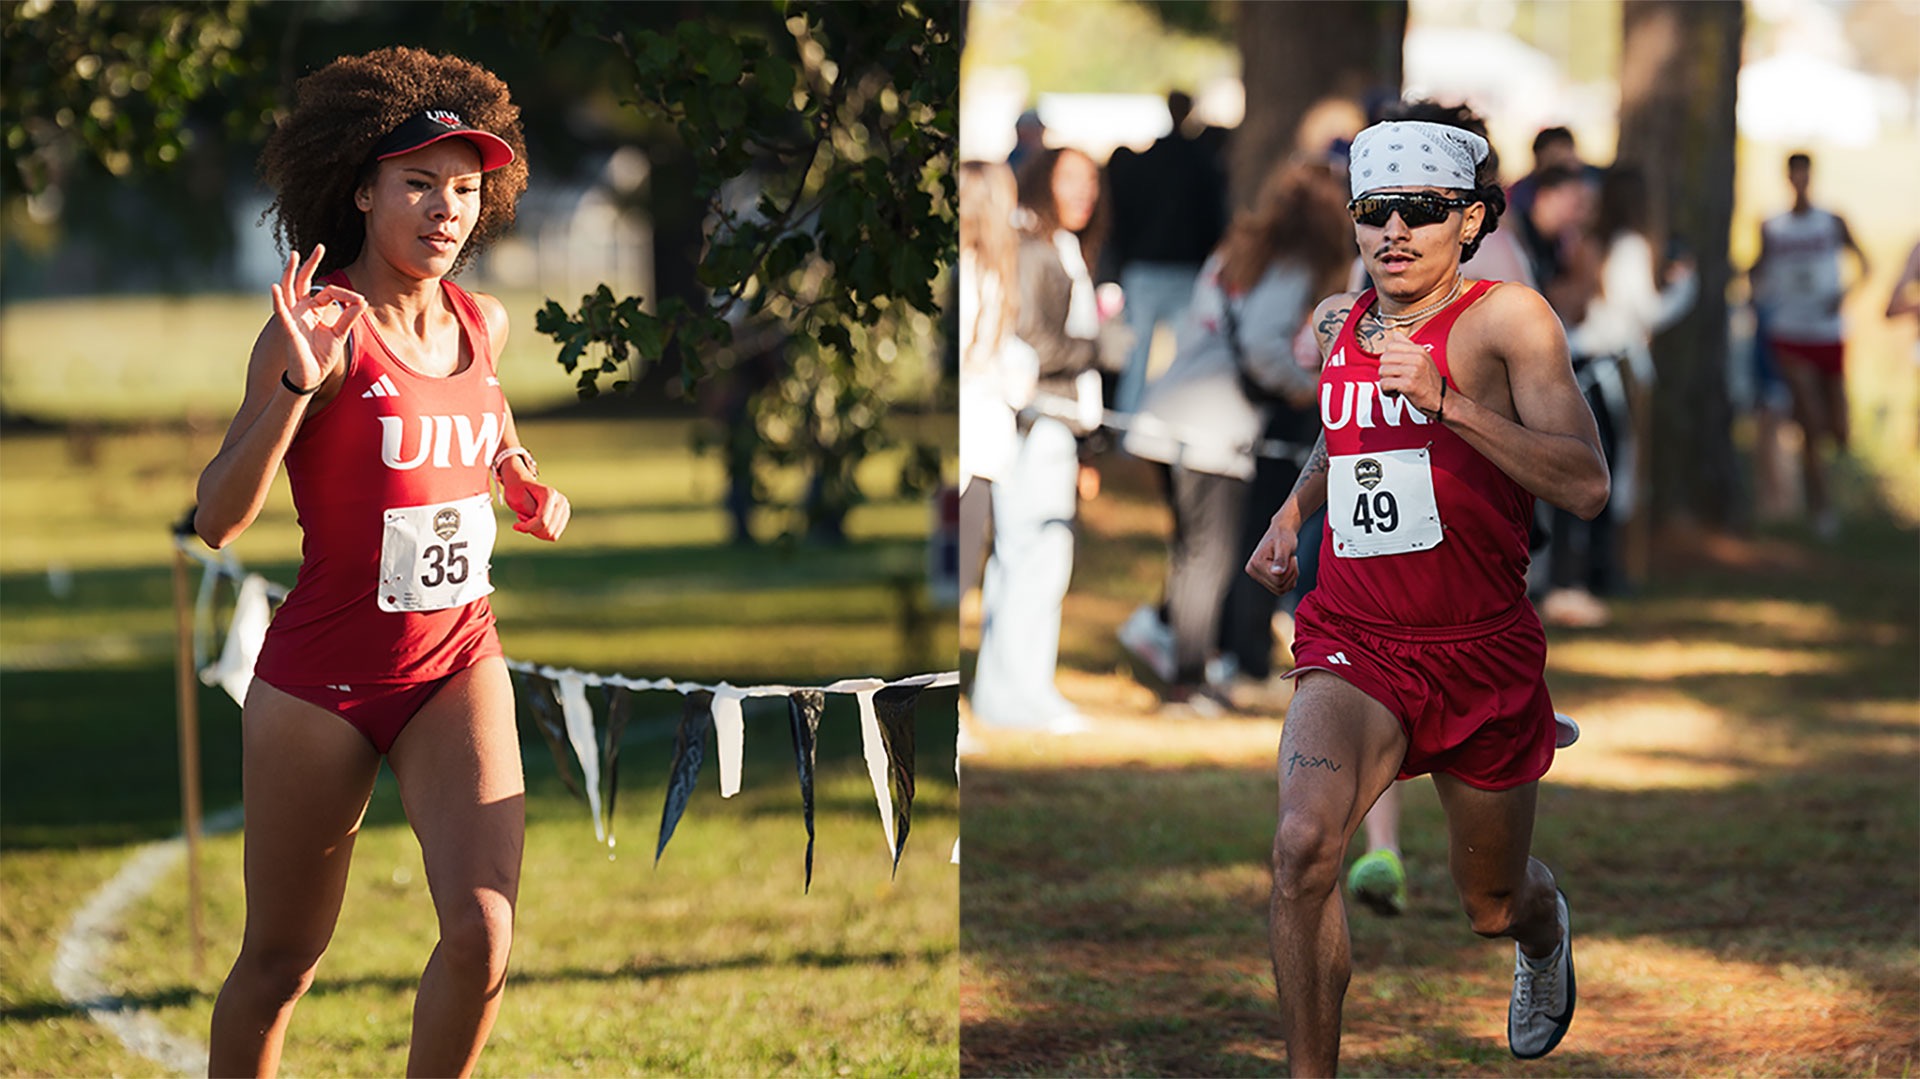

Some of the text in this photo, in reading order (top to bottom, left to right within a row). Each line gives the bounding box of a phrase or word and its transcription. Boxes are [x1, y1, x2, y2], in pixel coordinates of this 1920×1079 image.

[377, 412, 506, 470] UIW
[1352, 491, 1399, 534] 49
[421, 541, 469, 588] 35
